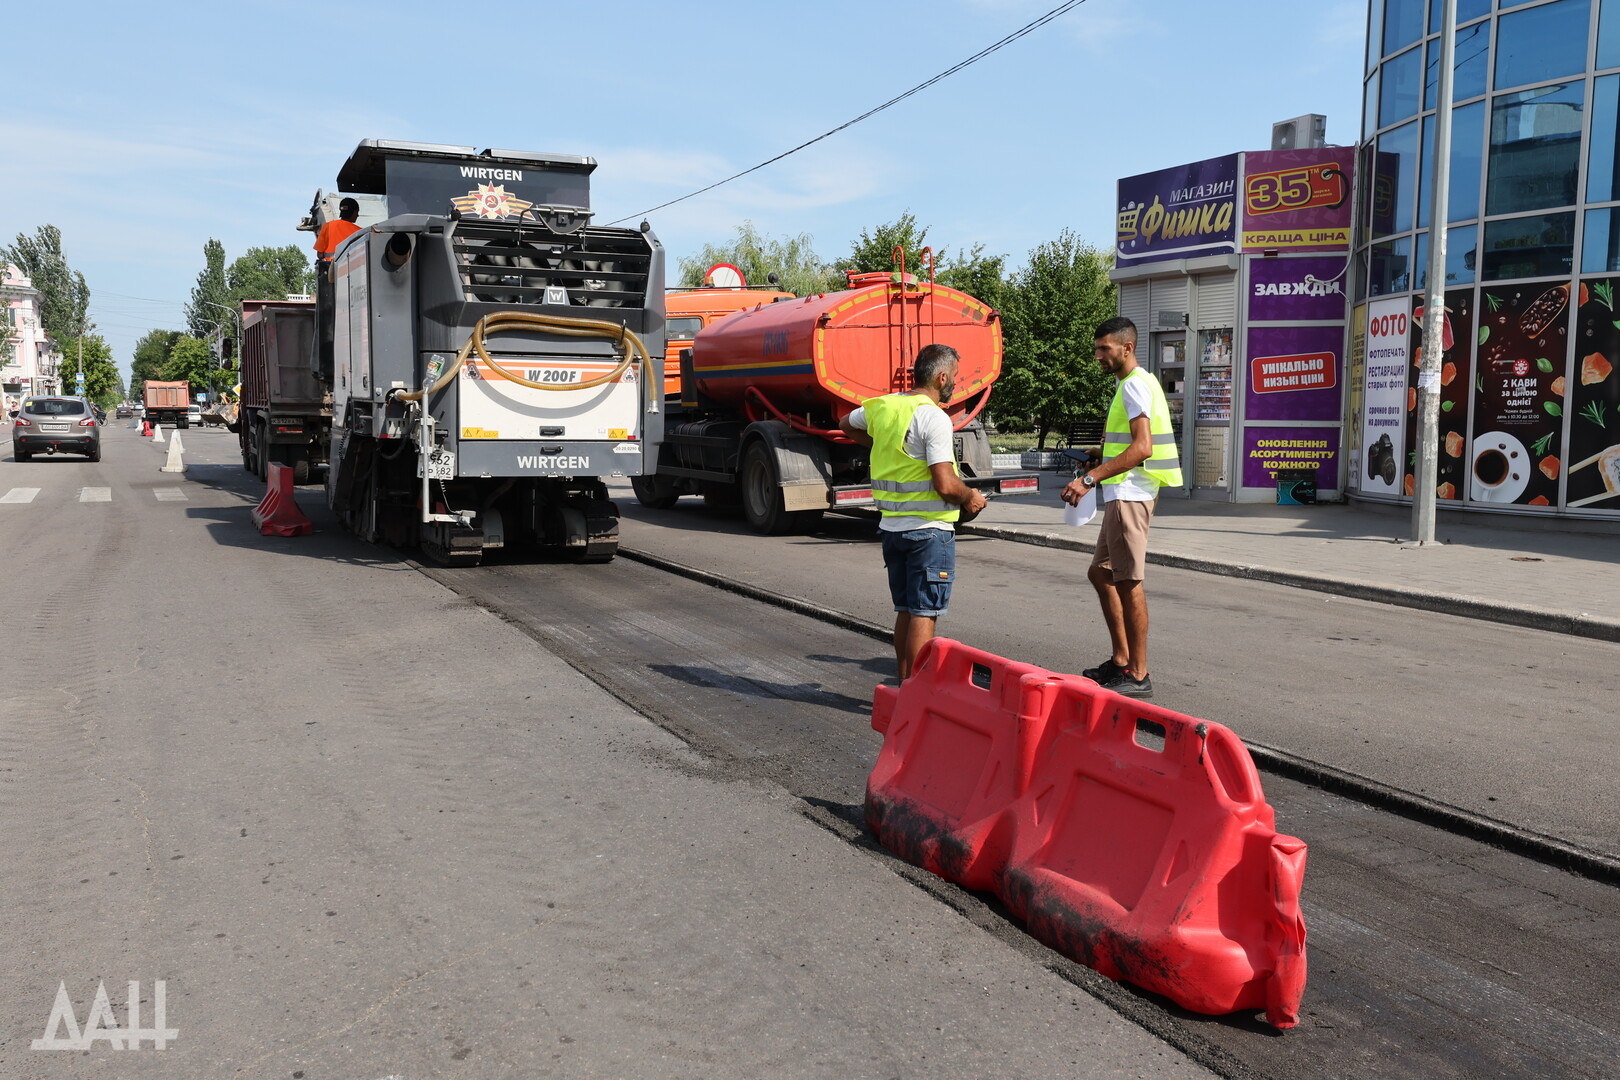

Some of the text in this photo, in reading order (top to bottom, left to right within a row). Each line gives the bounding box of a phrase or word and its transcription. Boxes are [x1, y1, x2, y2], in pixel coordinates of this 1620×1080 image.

[460, 166, 522, 181] WIRTGEN
[1169, 180, 1235, 203] МАГАЗИН
[1248, 170, 1312, 211] 35
[1140, 194, 1235, 246] Фишка
[1245, 232, 1347, 244] КРАЩА ЦІНА
[1254, 281, 1340, 297] ЗАВЖДИ
[1370, 313, 1407, 338] ФОТО
[1369, 347, 1405, 359] ФОТОПЕЧАТЬ
[1262, 359, 1324, 375] УНІКАЛЬНО
[1368, 365, 1405, 378] РЕСТАВРАЦИЯ
[528, 370, 541, 382] W
[1263, 373, 1325, 388] НИЗЬКІ ЦІНИ
[1367, 379, 1404, 391] старых фото
[1502, 378, 1537, 388] 2 КАВИ
[1506, 398, 1532, 406] однієї
[1368, 406, 1400, 416] срочное фото
[1368, 417, 1400, 427] на документы
[1257, 439, 1328, 448] ОНОВЛЕННЯ
[1249, 449, 1335, 459] АСОРТИМЕНТУ
[517, 456, 590, 469] WIRTGEN
[1263, 460, 1321, 469] КОЖНОГО
